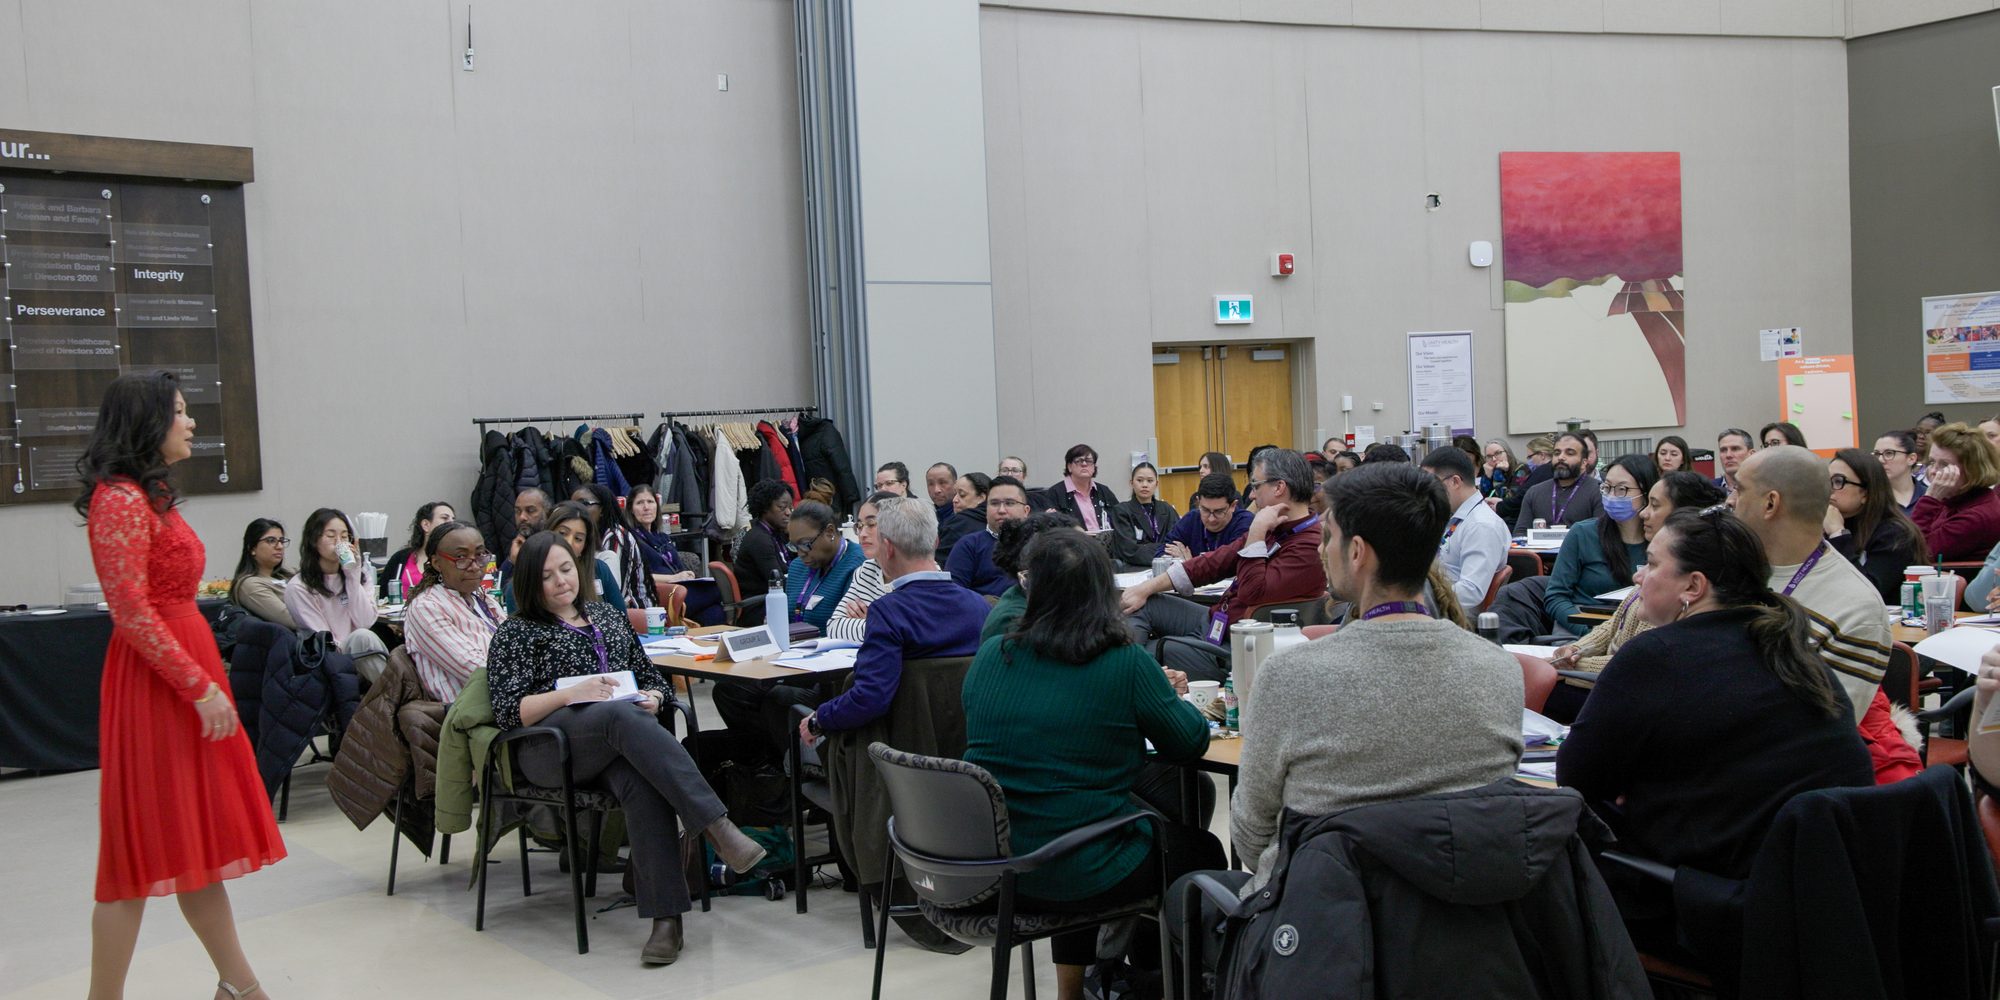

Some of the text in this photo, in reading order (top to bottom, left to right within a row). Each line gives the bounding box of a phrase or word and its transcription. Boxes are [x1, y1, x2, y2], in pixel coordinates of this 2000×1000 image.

[66, 205, 101, 214] Barbara
[52, 214, 70, 222] and
[71, 215, 99, 225] Family
[63, 252, 110, 261] Healthcare
[74, 263, 101, 272] Board
[34, 273, 76, 282] Directors
[134, 268, 185, 282] Integrity
[17, 304, 106, 317] Perseverance
[67, 338, 111, 346] Healthcare
[56, 347, 94, 355] Directors
[1369, 604, 1391, 616] HEALTH
